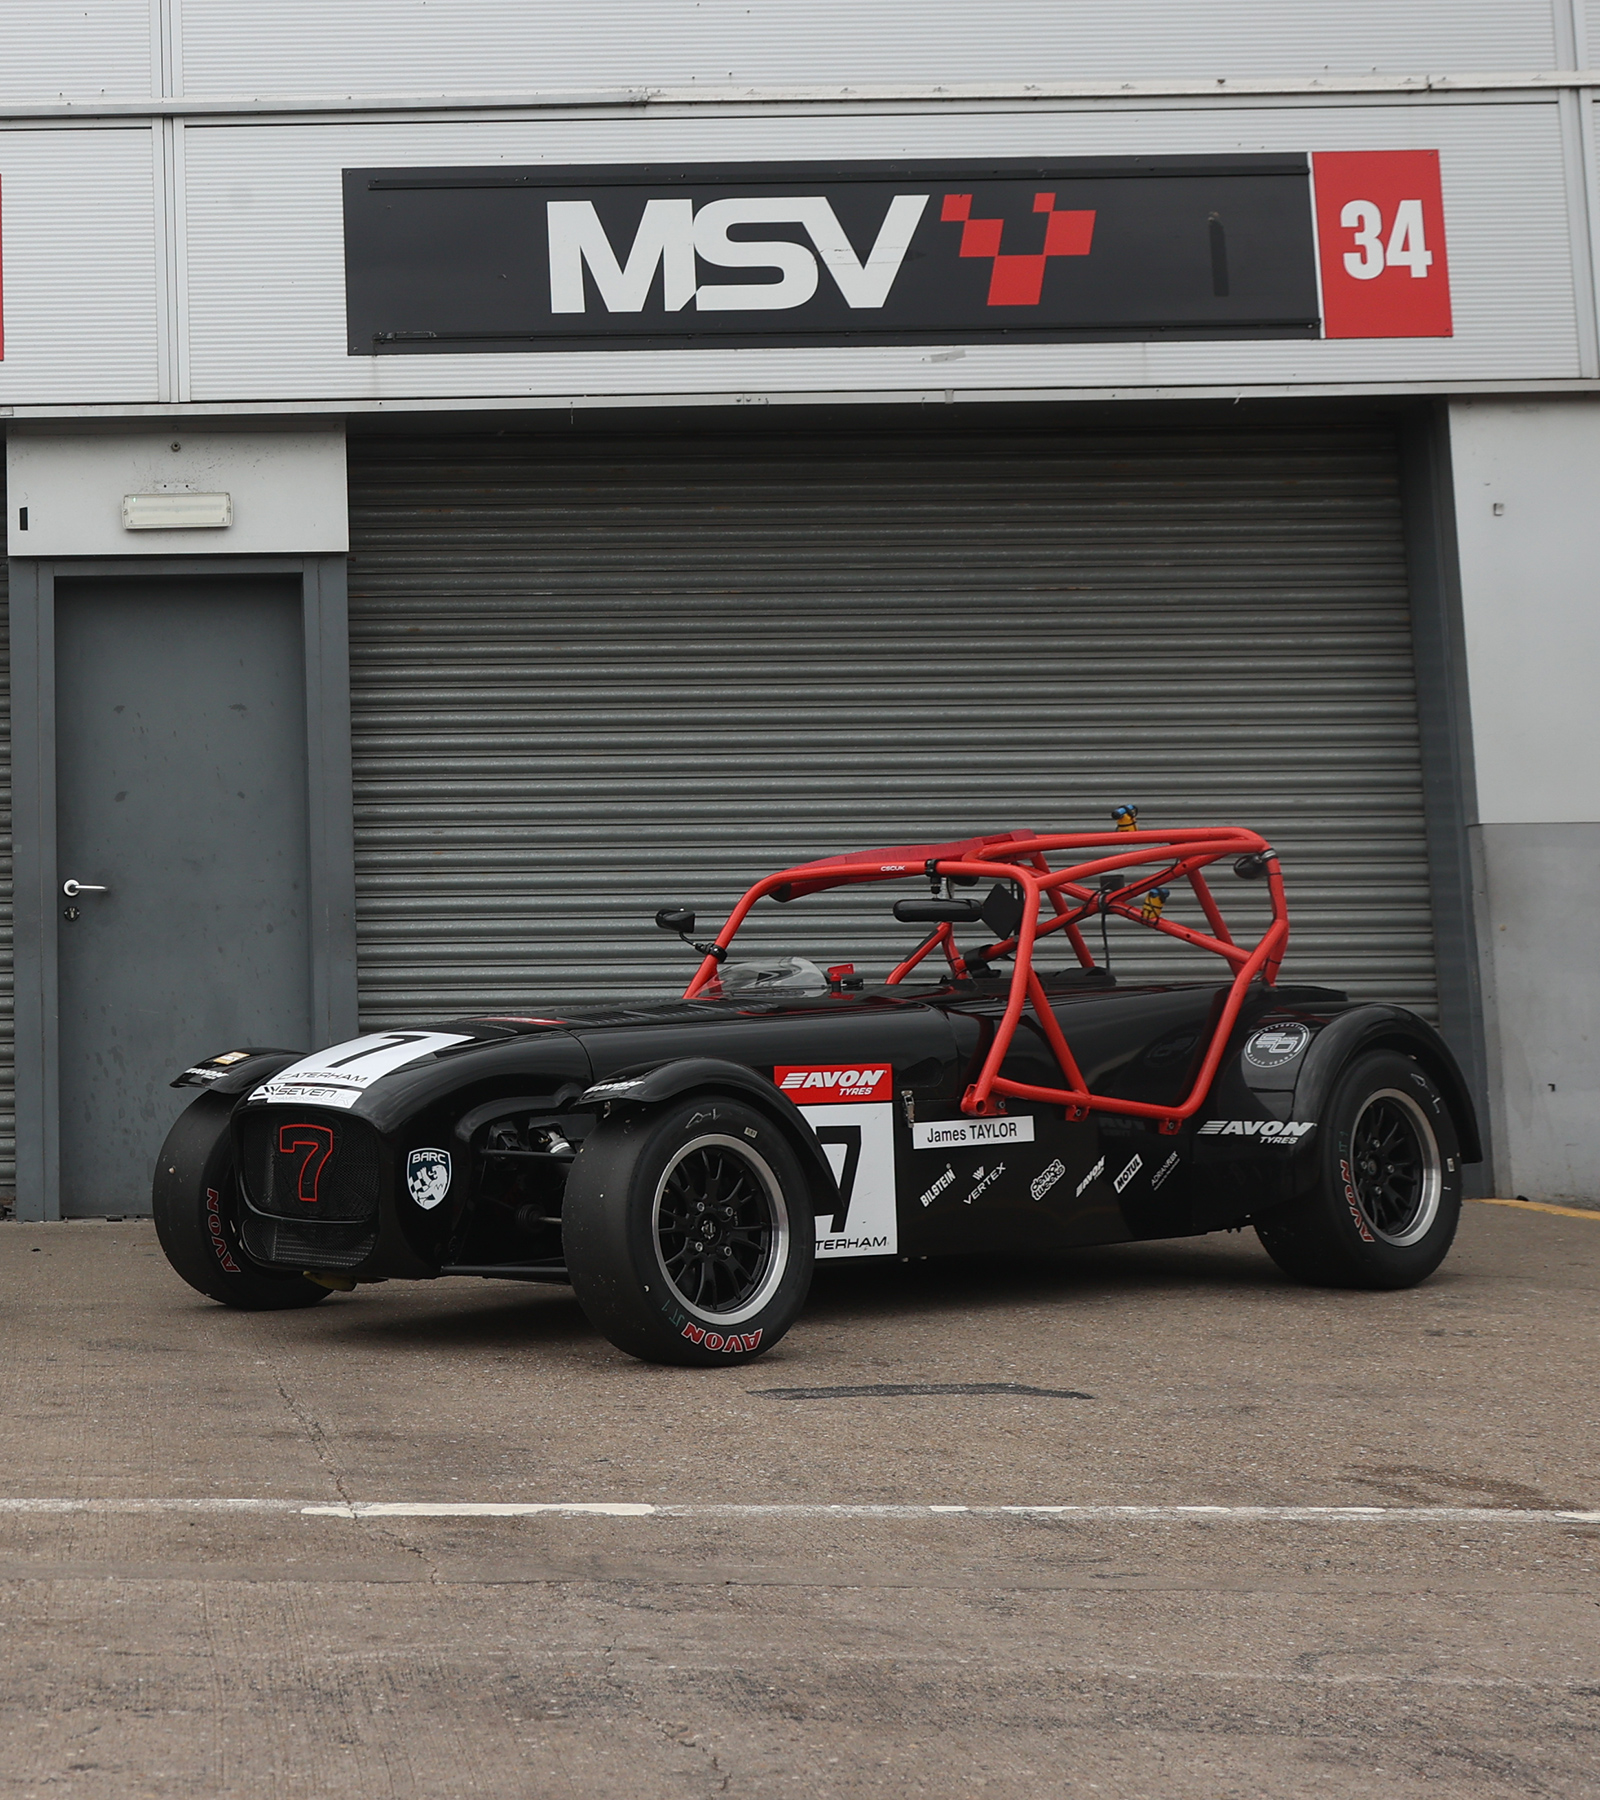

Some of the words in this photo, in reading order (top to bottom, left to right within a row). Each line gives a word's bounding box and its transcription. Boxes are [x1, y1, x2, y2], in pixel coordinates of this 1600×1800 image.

[546, 194, 931, 314] MSV
[1340, 199, 1433, 280] 34
[324, 1034, 432, 1069] 7
[277, 1071, 369, 1084] CATERHAM
[802, 1069, 886, 1088] AVON
[838, 1087, 873, 1096] TYRES
[926, 1127, 967, 1143] James
[969, 1122, 1018, 1140] TAYLOR
[1220, 1120, 1315, 1136] AVON
[1259, 1136, 1299, 1145] TYRES
[279, 1123, 334, 1203] 7
[412, 1151, 447, 1164] BARC
[1116, 1157, 1141, 1191] MOTUL
[815, 1124, 862, 1233] 7
[919, 1168, 957, 1208] BILSTEIN
[963, 1161, 1007, 1205] VERTEX
[1339, 1159, 1376, 1242] AVON
[206, 1187, 242, 1273] AVON
[815, 1235, 888, 1251] TERHAM
[680, 1321, 764, 1354] AVON
